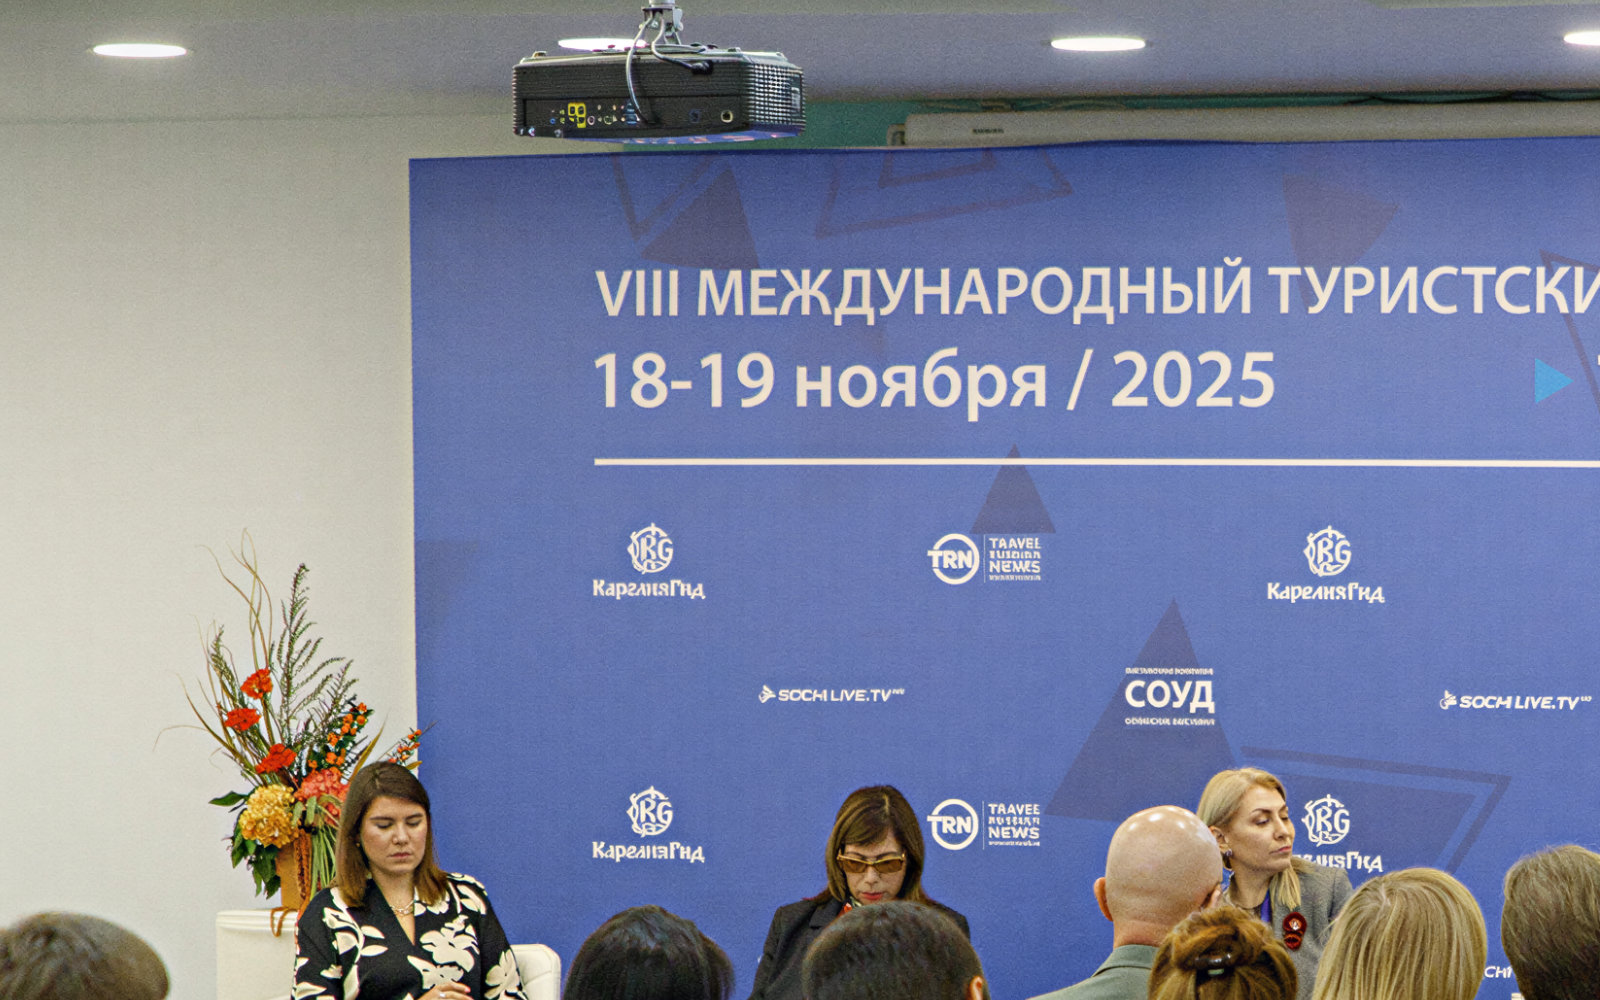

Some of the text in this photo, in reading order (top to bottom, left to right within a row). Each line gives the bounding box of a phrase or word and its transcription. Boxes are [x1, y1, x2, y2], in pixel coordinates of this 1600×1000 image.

[596, 269, 679, 317] VIII
[697, 256, 1252, 326] МЕЖДУНАРОДНЫЙ
[595, 347, 1275, 423] 18-19 ноября / 2025
[927, 550, 973, 569] TRN
[1125, 680, 1215, 714] СОУД
[927, 815, 972, 834] TRN
[988, 826, 1040, 839] NEWS
